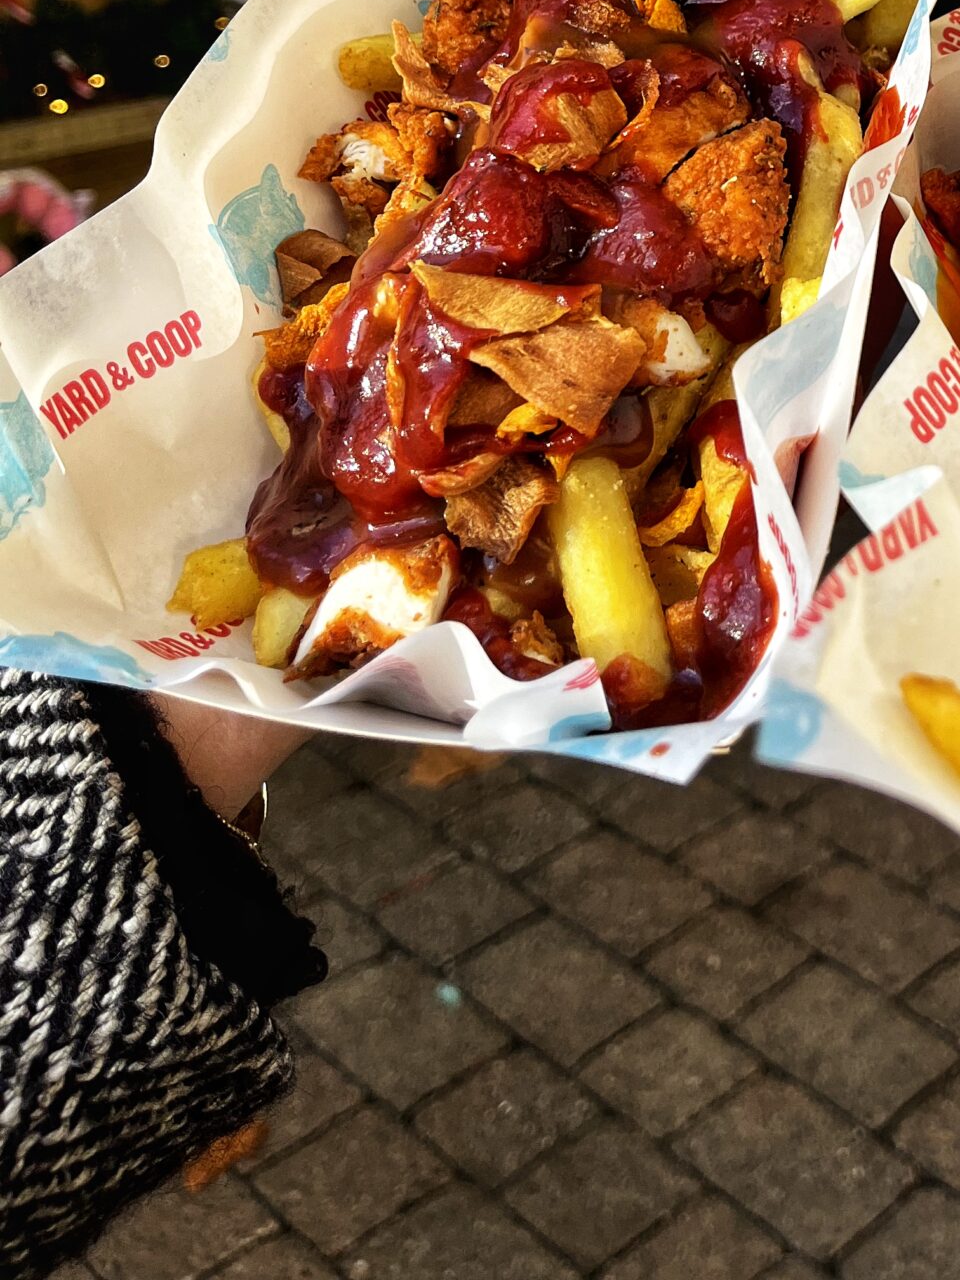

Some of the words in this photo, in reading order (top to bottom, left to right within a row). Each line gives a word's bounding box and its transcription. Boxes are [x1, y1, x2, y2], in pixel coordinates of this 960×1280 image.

[39, 368, 112, 440] YARD
[106, 361, 135, 391] &
[127, 309, 202, 379] COOP
[856, 496, 939, 574] YARD
[179, 631, 215, 651] &
